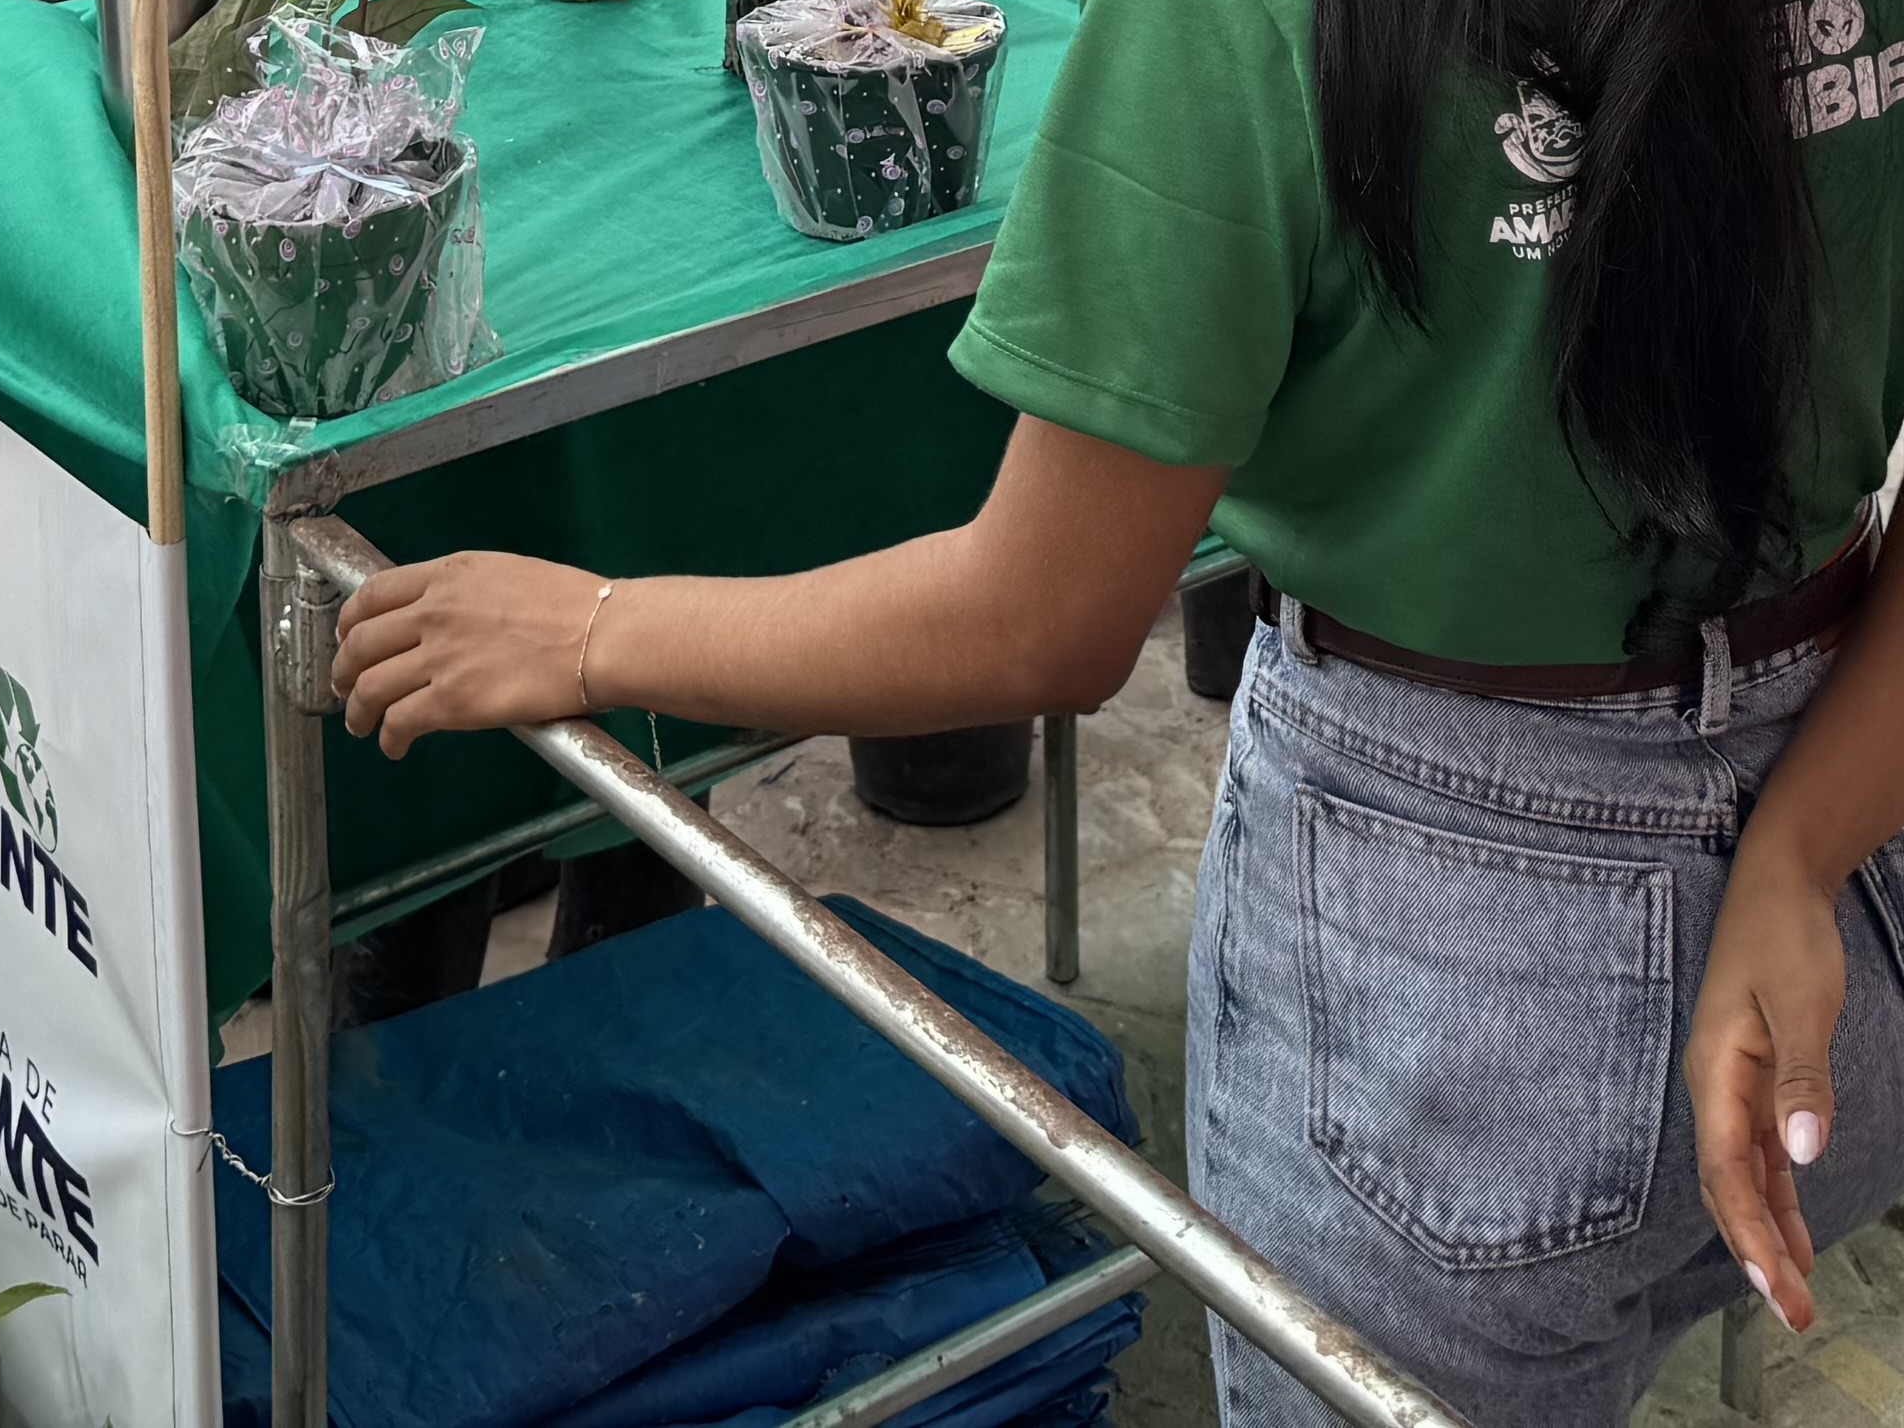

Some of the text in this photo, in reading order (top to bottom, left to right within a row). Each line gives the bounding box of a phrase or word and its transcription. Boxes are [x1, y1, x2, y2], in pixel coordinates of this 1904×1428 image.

[1489, 198, 1576, 244] AMAR
[1512, 246, 1542, 260] UM
[26, 1057, 57, 1125] DE
[27, 1210, 88, 1291] PARAR
